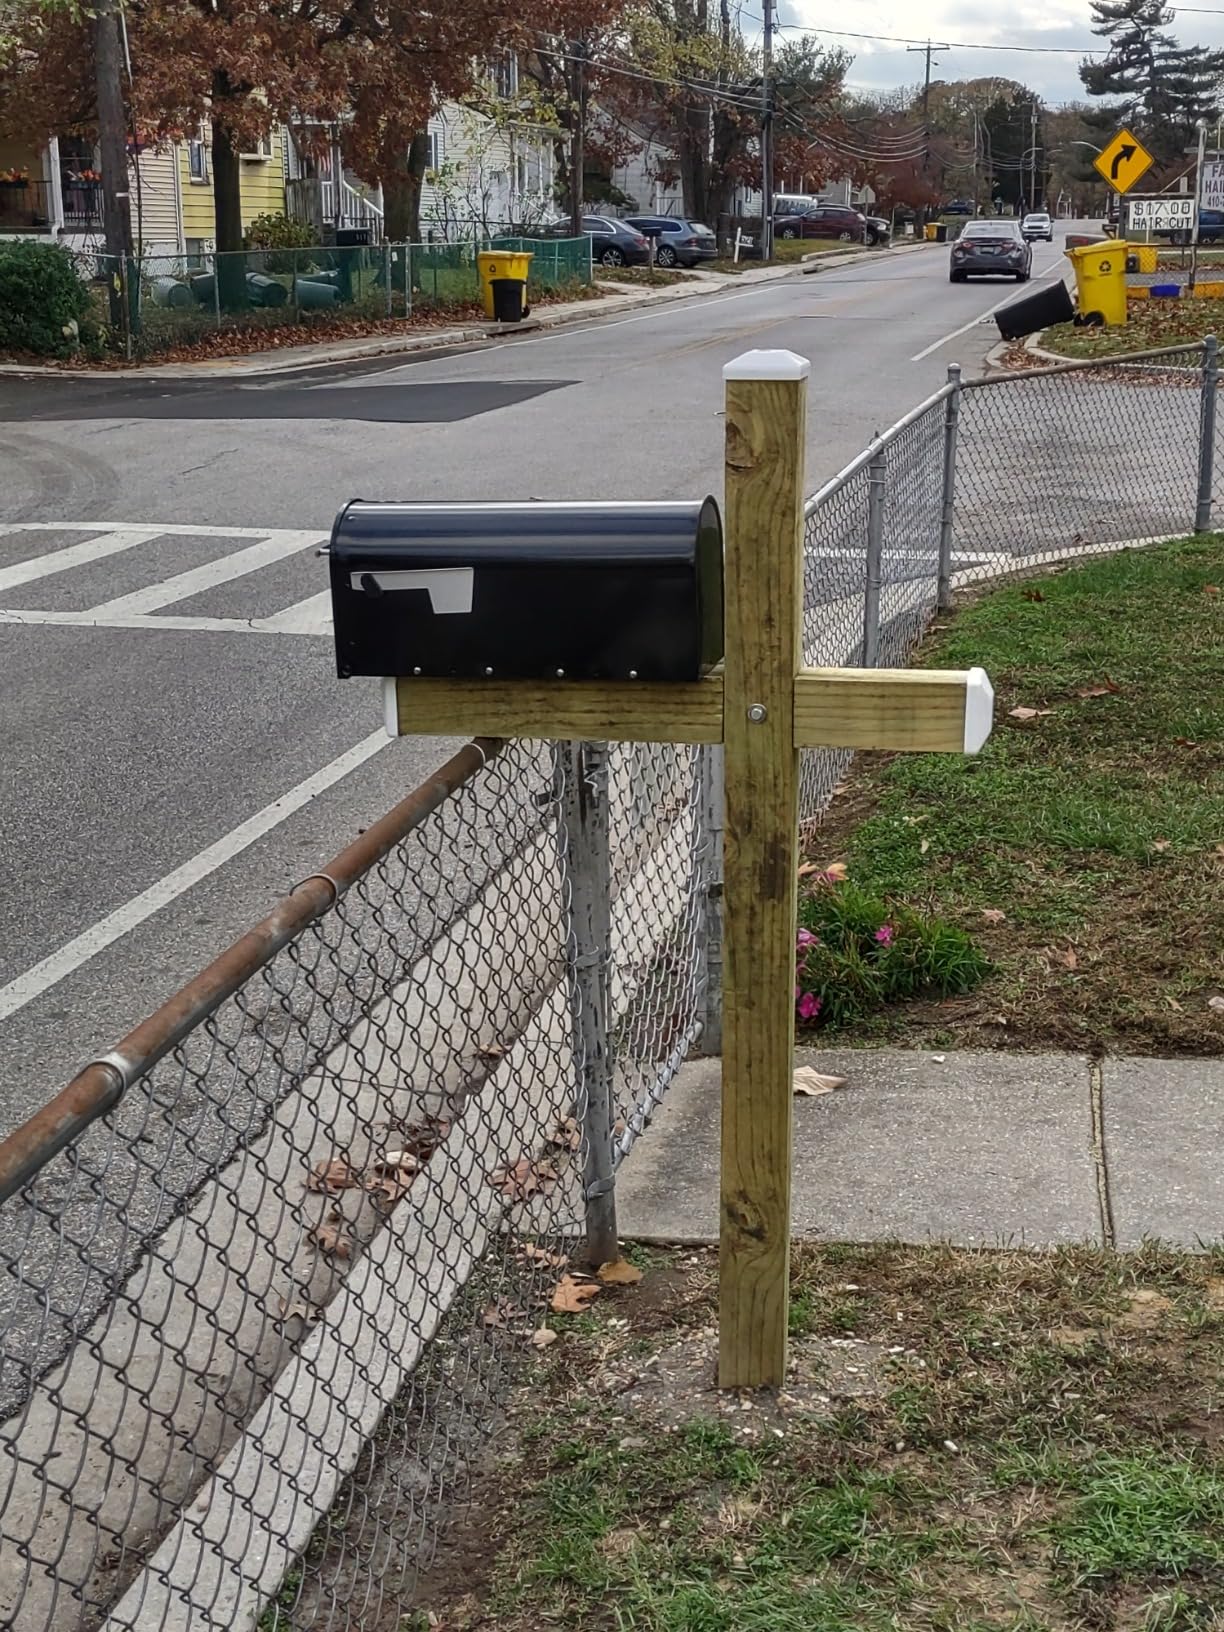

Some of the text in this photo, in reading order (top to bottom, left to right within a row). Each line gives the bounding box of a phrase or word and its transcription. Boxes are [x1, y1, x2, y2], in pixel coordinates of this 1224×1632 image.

[1205, 180, 1224, 193] HAI
[1132, 217, 1192, 229] HAIR CUT
